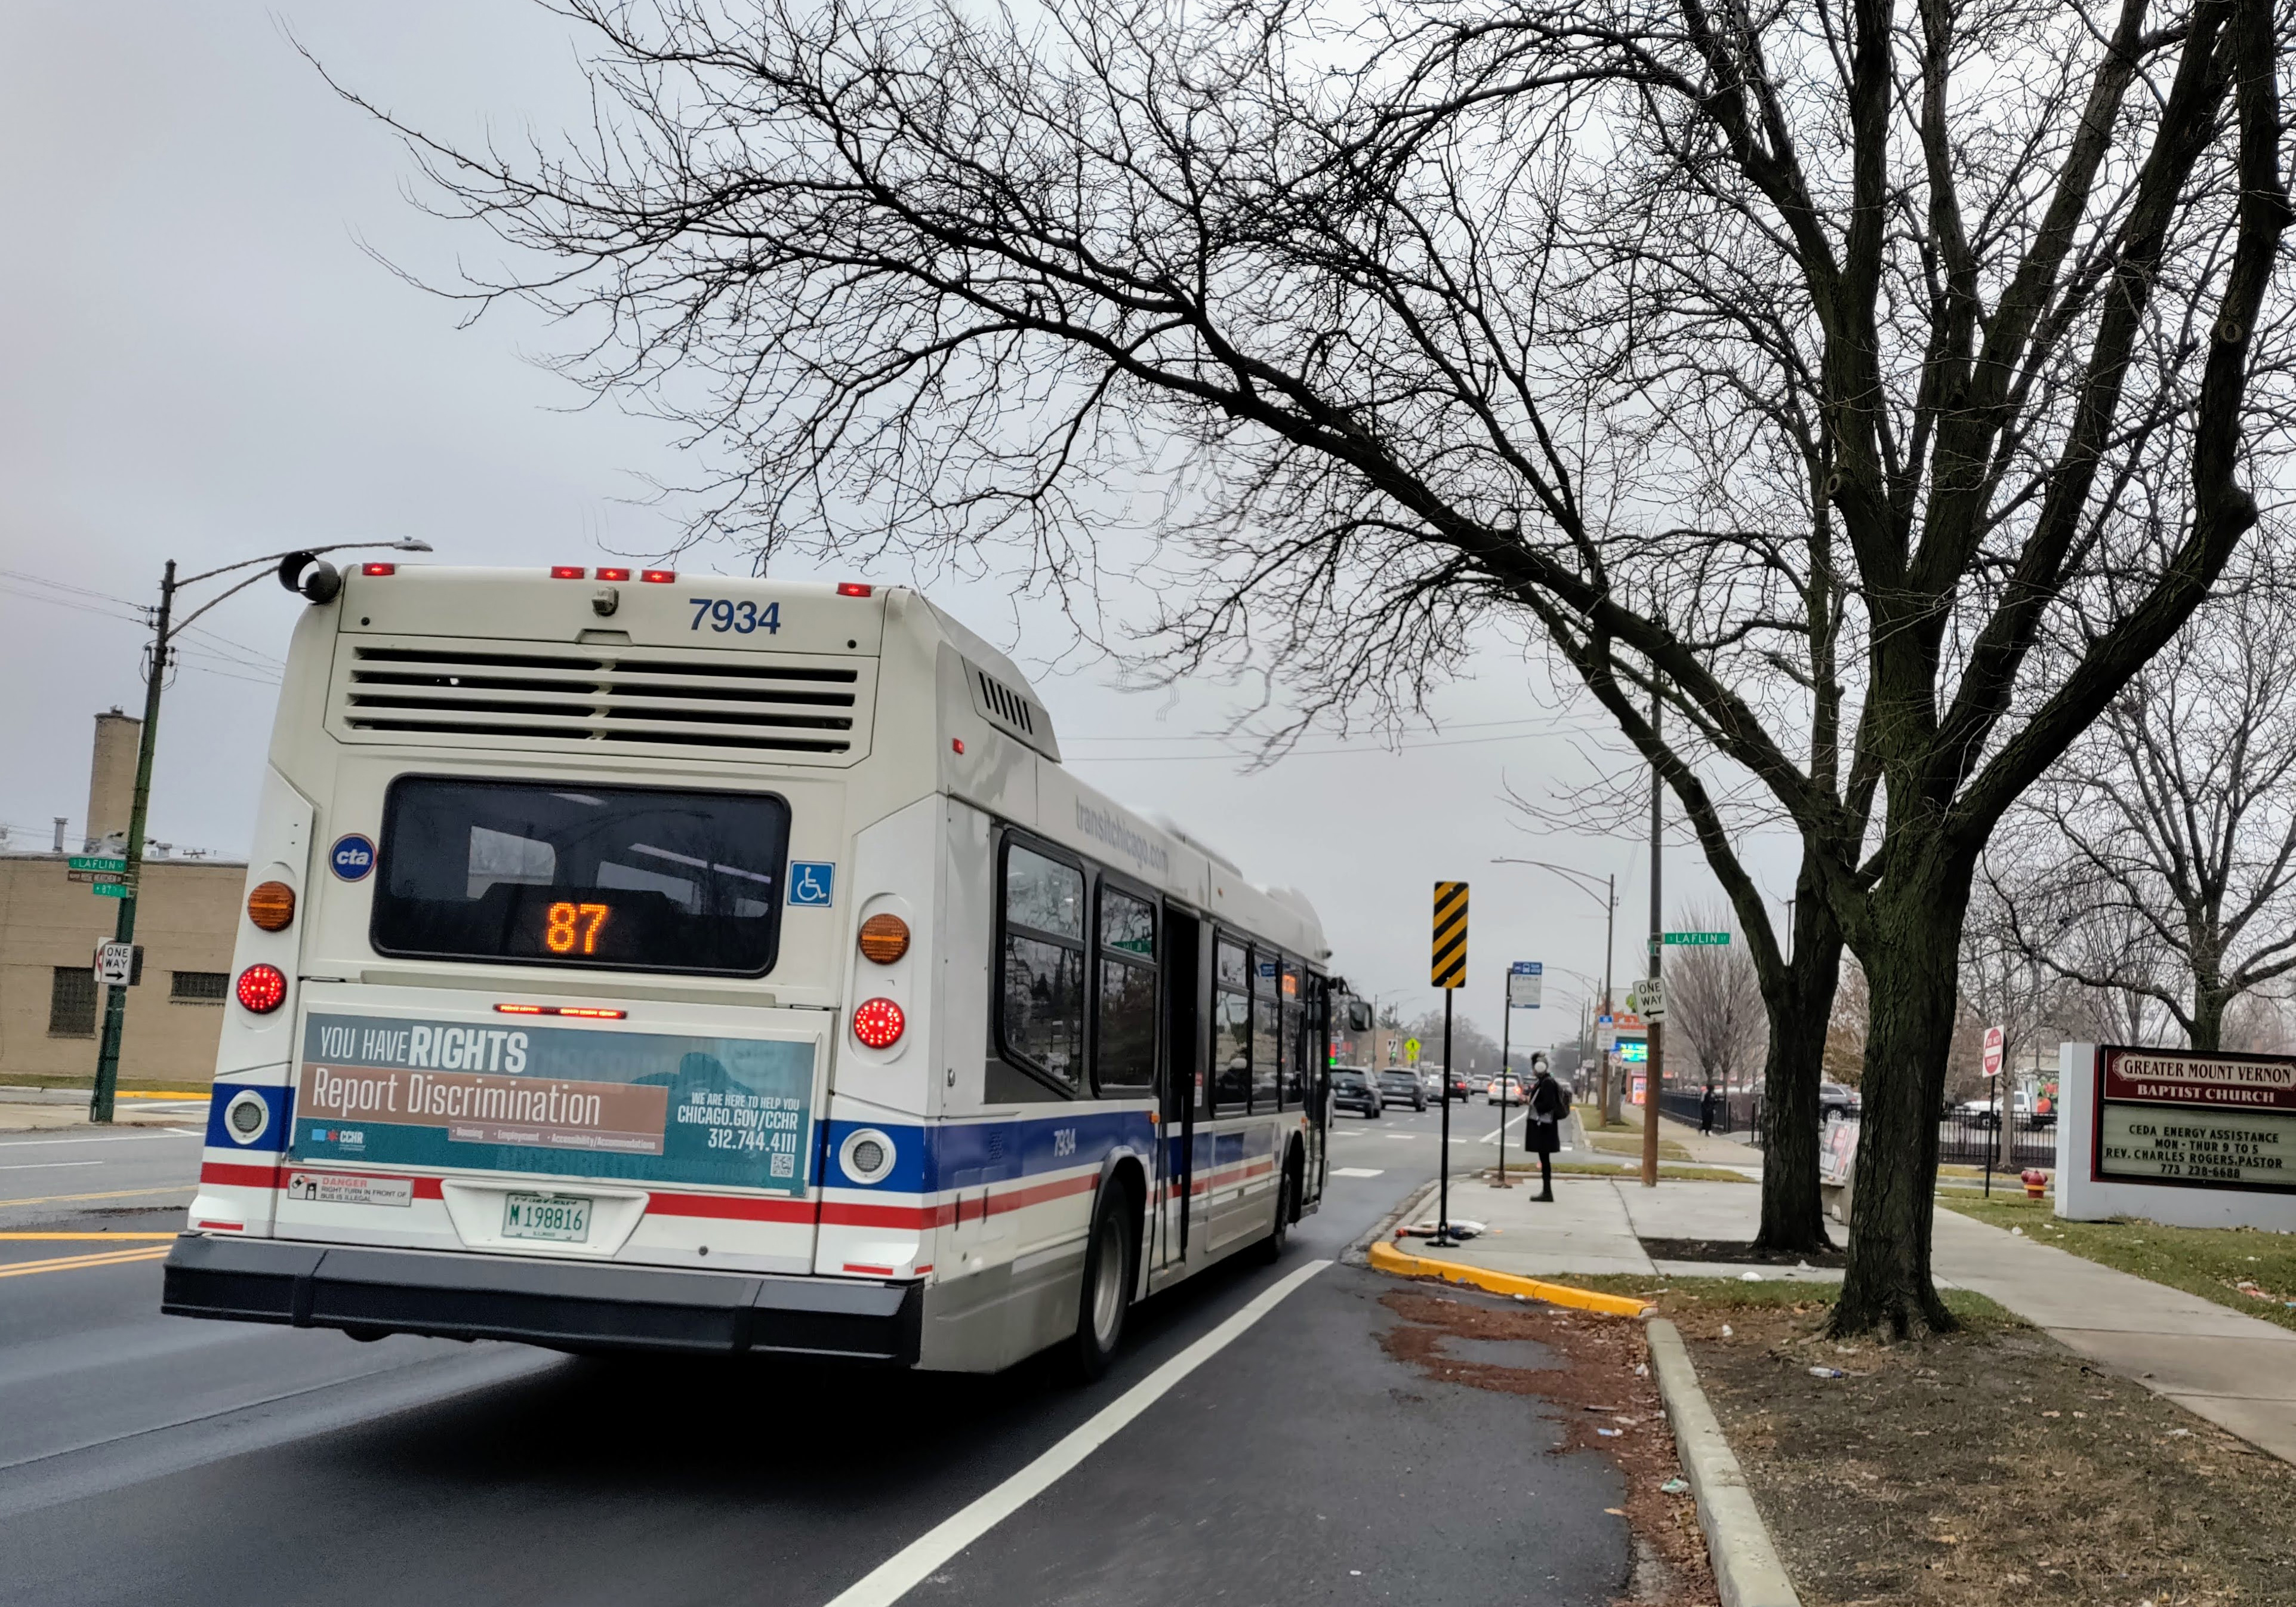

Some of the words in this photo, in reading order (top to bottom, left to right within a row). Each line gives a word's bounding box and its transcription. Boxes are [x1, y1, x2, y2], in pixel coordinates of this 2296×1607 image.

[689, 598, 781, 635] 7934
[1076, 795, 1169, 875] transitchicago.com
[79, 860, 115, 869] LAFLIN
[337, 848, 369, 865] cta
[548, 903, 606, 952] 87
[1675, 934, 1718, 943] LAFLIN
[107, 947, 128, 958] ONE
[106, 958, 128, 968] WAY
[1639, 982, 1661, 994] ONE
[1641, 995, 1662, 1006] WAY
[321, 1026, 356, 1058] YOU
[362, 1029, 409, 1063] HAVE
[408, 1026, 528, 1073] RIGHTS
[2124, 1060, 2183, 1077] GREATER
[2189, 1063, 2233, 1080] MOUNT
[2238, 1066, 2290, 1083] VERNON
[313, 1067, 398, 1117] Report
[407, 1073, 600, 1125] Discrimination
[692, 1092, 705, 1104] WE
[707, 1093, 723, 1106] ARE
[725, 1094, 745, 1107] HERE
[748, 1095, 758, 1109] TO
[760, 1097, 781, 1110] HELP
[784, 1098, 800, 1111] YOU
[2137, 1084, 2202, 1098] BAPTIST
[2205, 1088, 2275, 1103] CHURCH
[677, 1105, 798, 1132] CHICAGO.GOV/CCHR
[340, 1130, 364, 1144] CCHR
[708, 1128, 797, 1153] 312.744.4111
[1054, 1128, 1076, 1157] 7934
[2129, 1125, 2157, 1135] CEDA
[2164, 1126, 2206, 1138] ENERGY
[2210, 1129, 2279, 1143] ASSISTANCE
[2106, 1147, 2131, 1158] REV.
[2134, 1149, 2184, 1162] CHARLES
[2155, 1138, 2178, 1149] MON
[2190, 1140, 2218, 1152] THUR
[2223, 1143, 2229, 1152] 9
[2235, 1143, 2248, 1154] TO
[2252, 1144, 2258, 1155] 5
[2161, 1163, 2180, 1175] 773
[322, 1177, 367, 1187] DANGER
[524, 1205, 583, 1230] 198816
